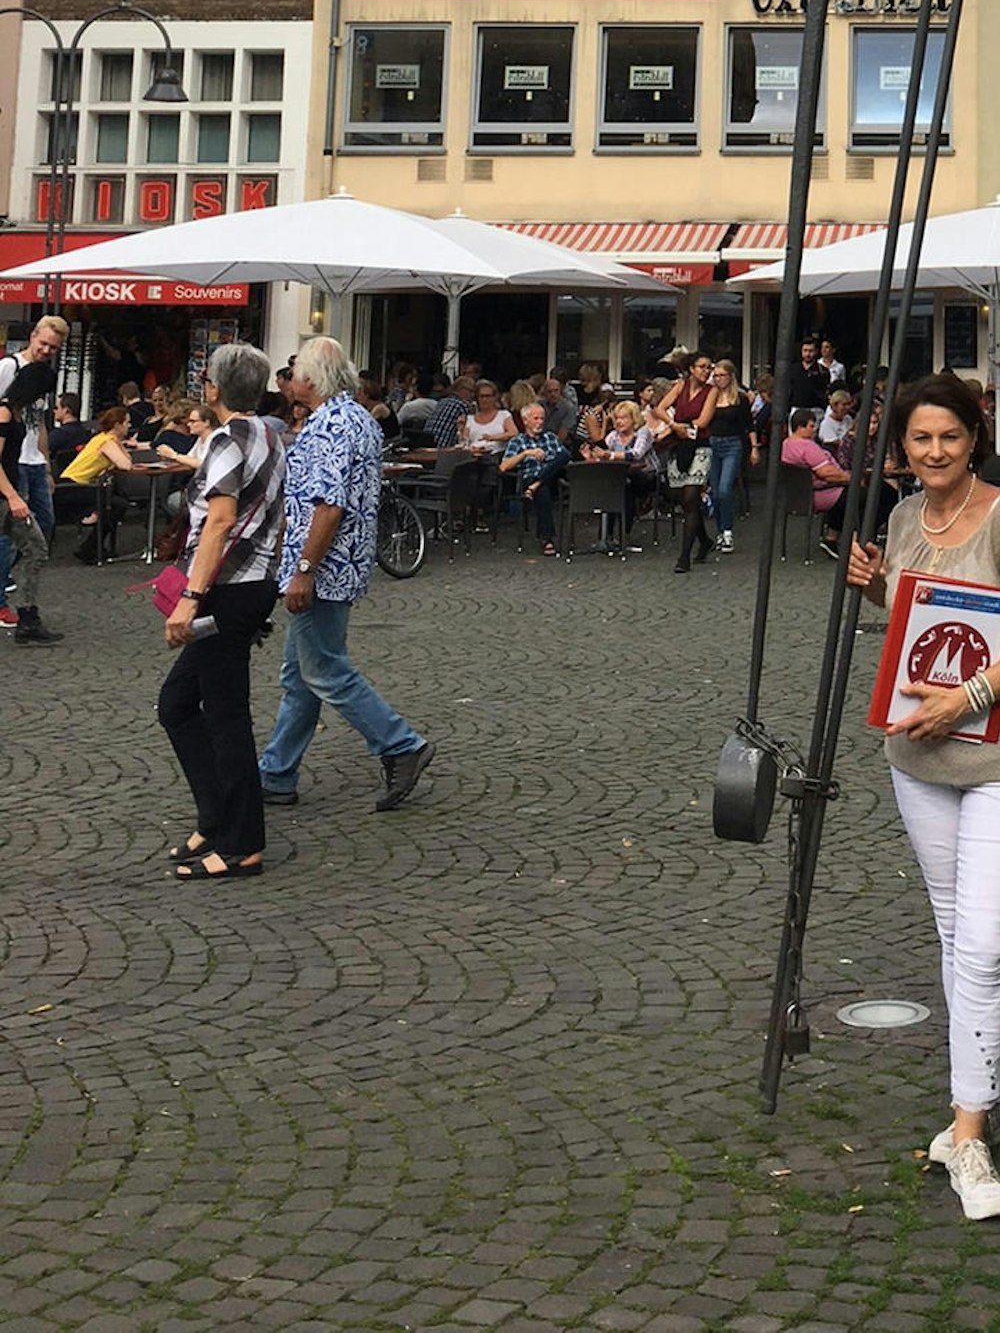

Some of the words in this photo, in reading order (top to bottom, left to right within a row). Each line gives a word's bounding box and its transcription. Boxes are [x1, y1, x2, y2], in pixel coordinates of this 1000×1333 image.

[65, 282, 136, 301] KIOSK
[174, 284, 243, 299] Souvenirs
[932, 671, 959, 682] Köln
